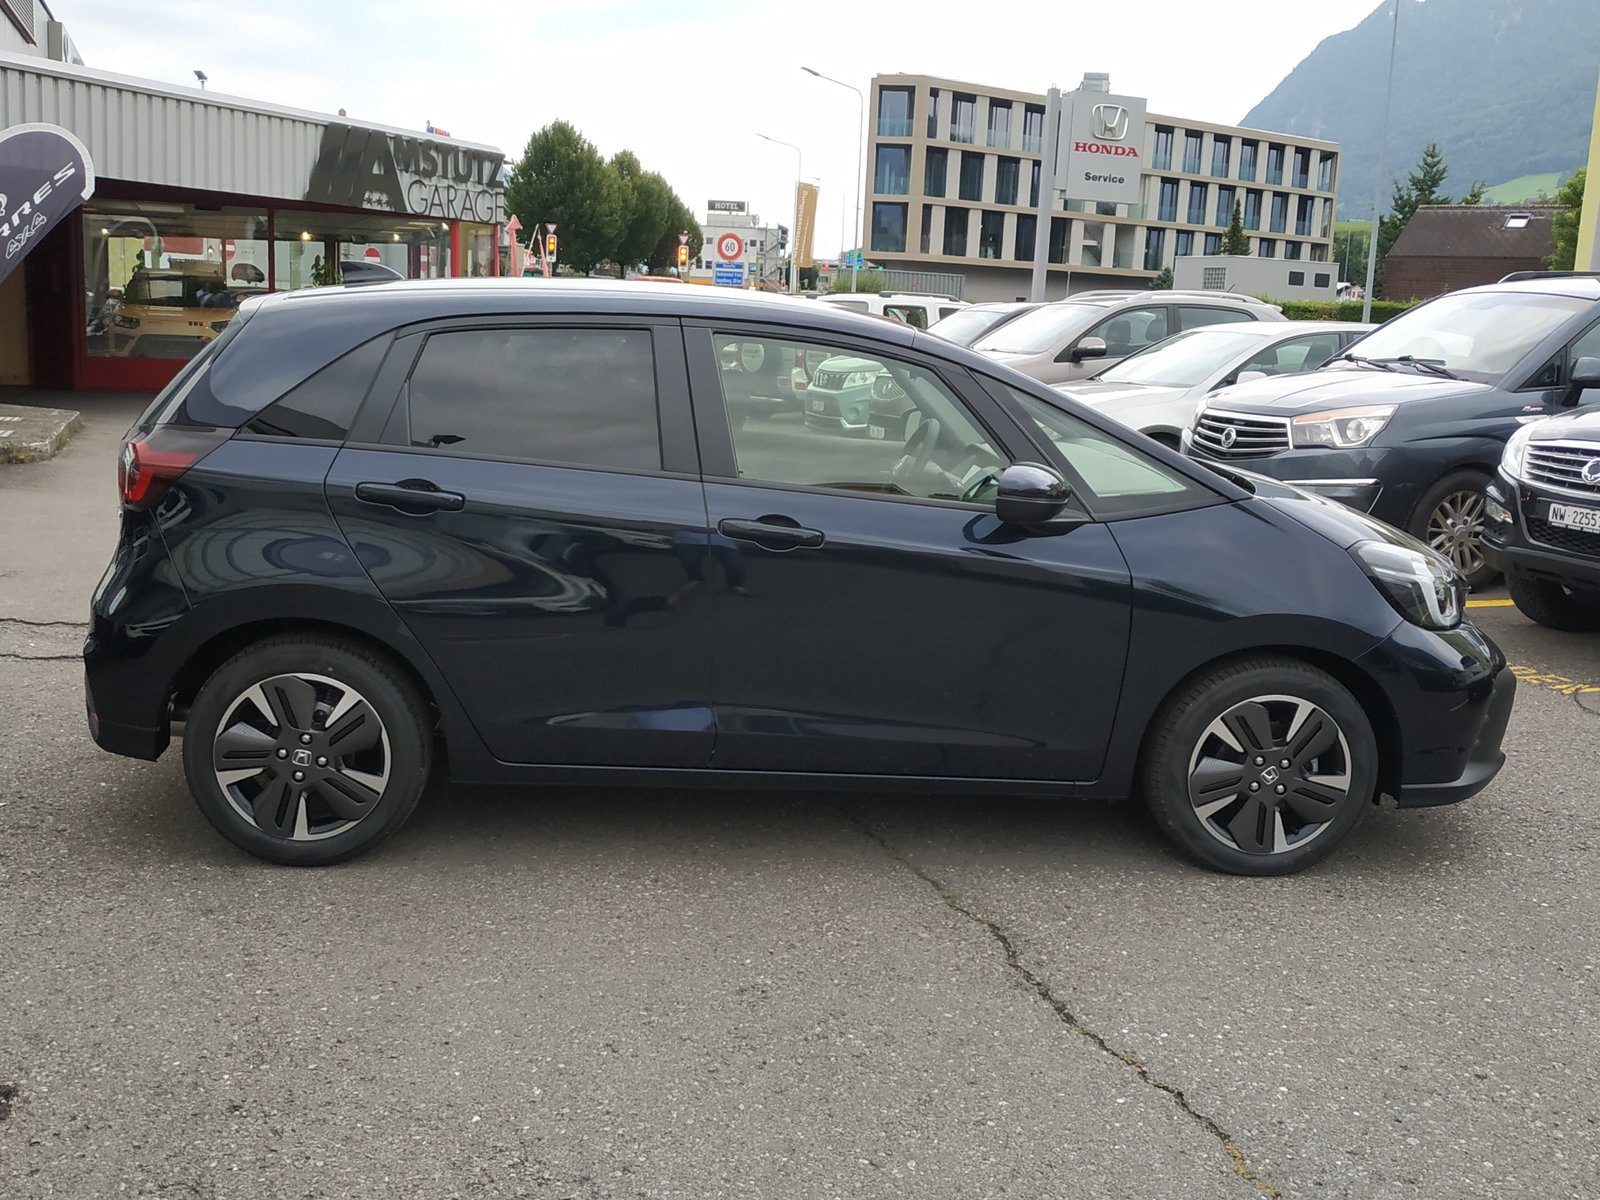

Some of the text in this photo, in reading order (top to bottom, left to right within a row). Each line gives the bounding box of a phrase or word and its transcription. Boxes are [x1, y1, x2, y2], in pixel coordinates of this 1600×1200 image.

[1073, 141, 1139, 158] HONDA
[1084, 171, 1125, 184] Service
[406, 179, 505, 223] GARAGE
[714, 202, 739, 210] HOTEL
[724, 242, 736, 252] 60
[1551, 506, 1567, 521] NW
